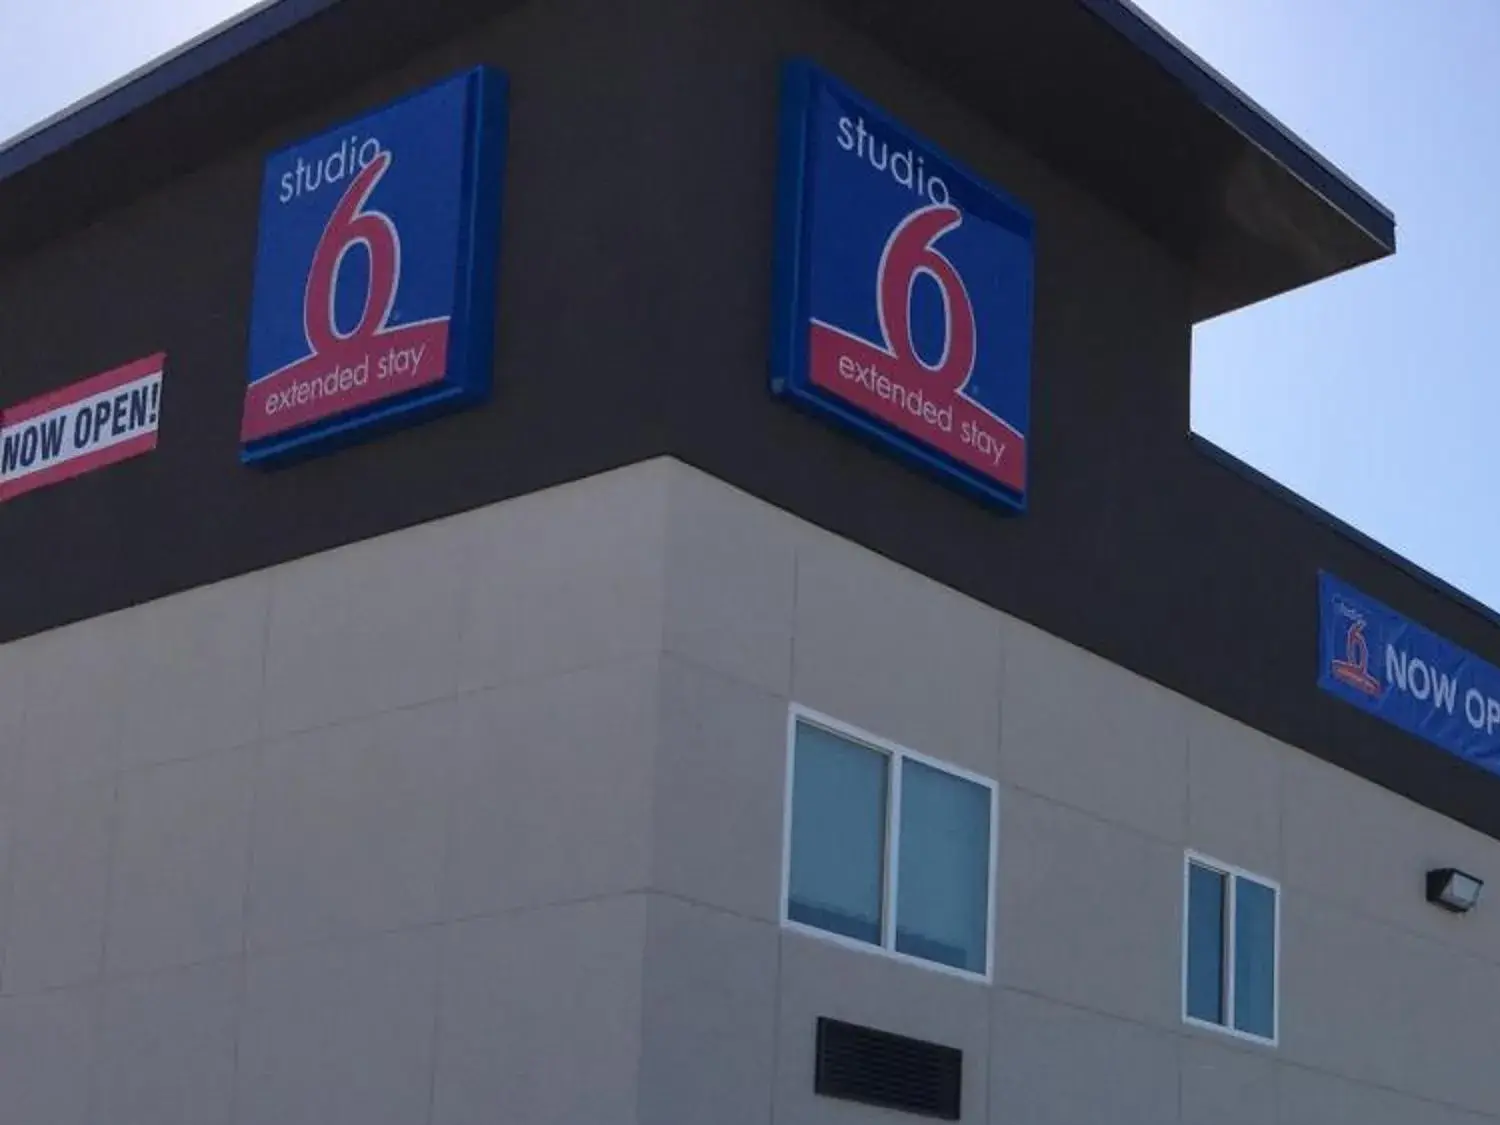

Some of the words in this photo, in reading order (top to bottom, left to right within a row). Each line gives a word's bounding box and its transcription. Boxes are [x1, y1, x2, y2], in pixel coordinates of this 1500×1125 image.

[279, 136, 383, 204] studio
[836, 114, 951, 206] studio
[304, 150, 401, 356] 6
[877, 204, 977, 394] 6
[264, 359, 370, 416] extended
[377, 343, 426, 380] stay
[838, 351, 953, 433] extended
[960, 416, 1006, 465] stay
[2, 415, 67, 475] NOW
[74, 382, 158, 449] OPEN!
[1386, 643, 1458, 716] NOW
